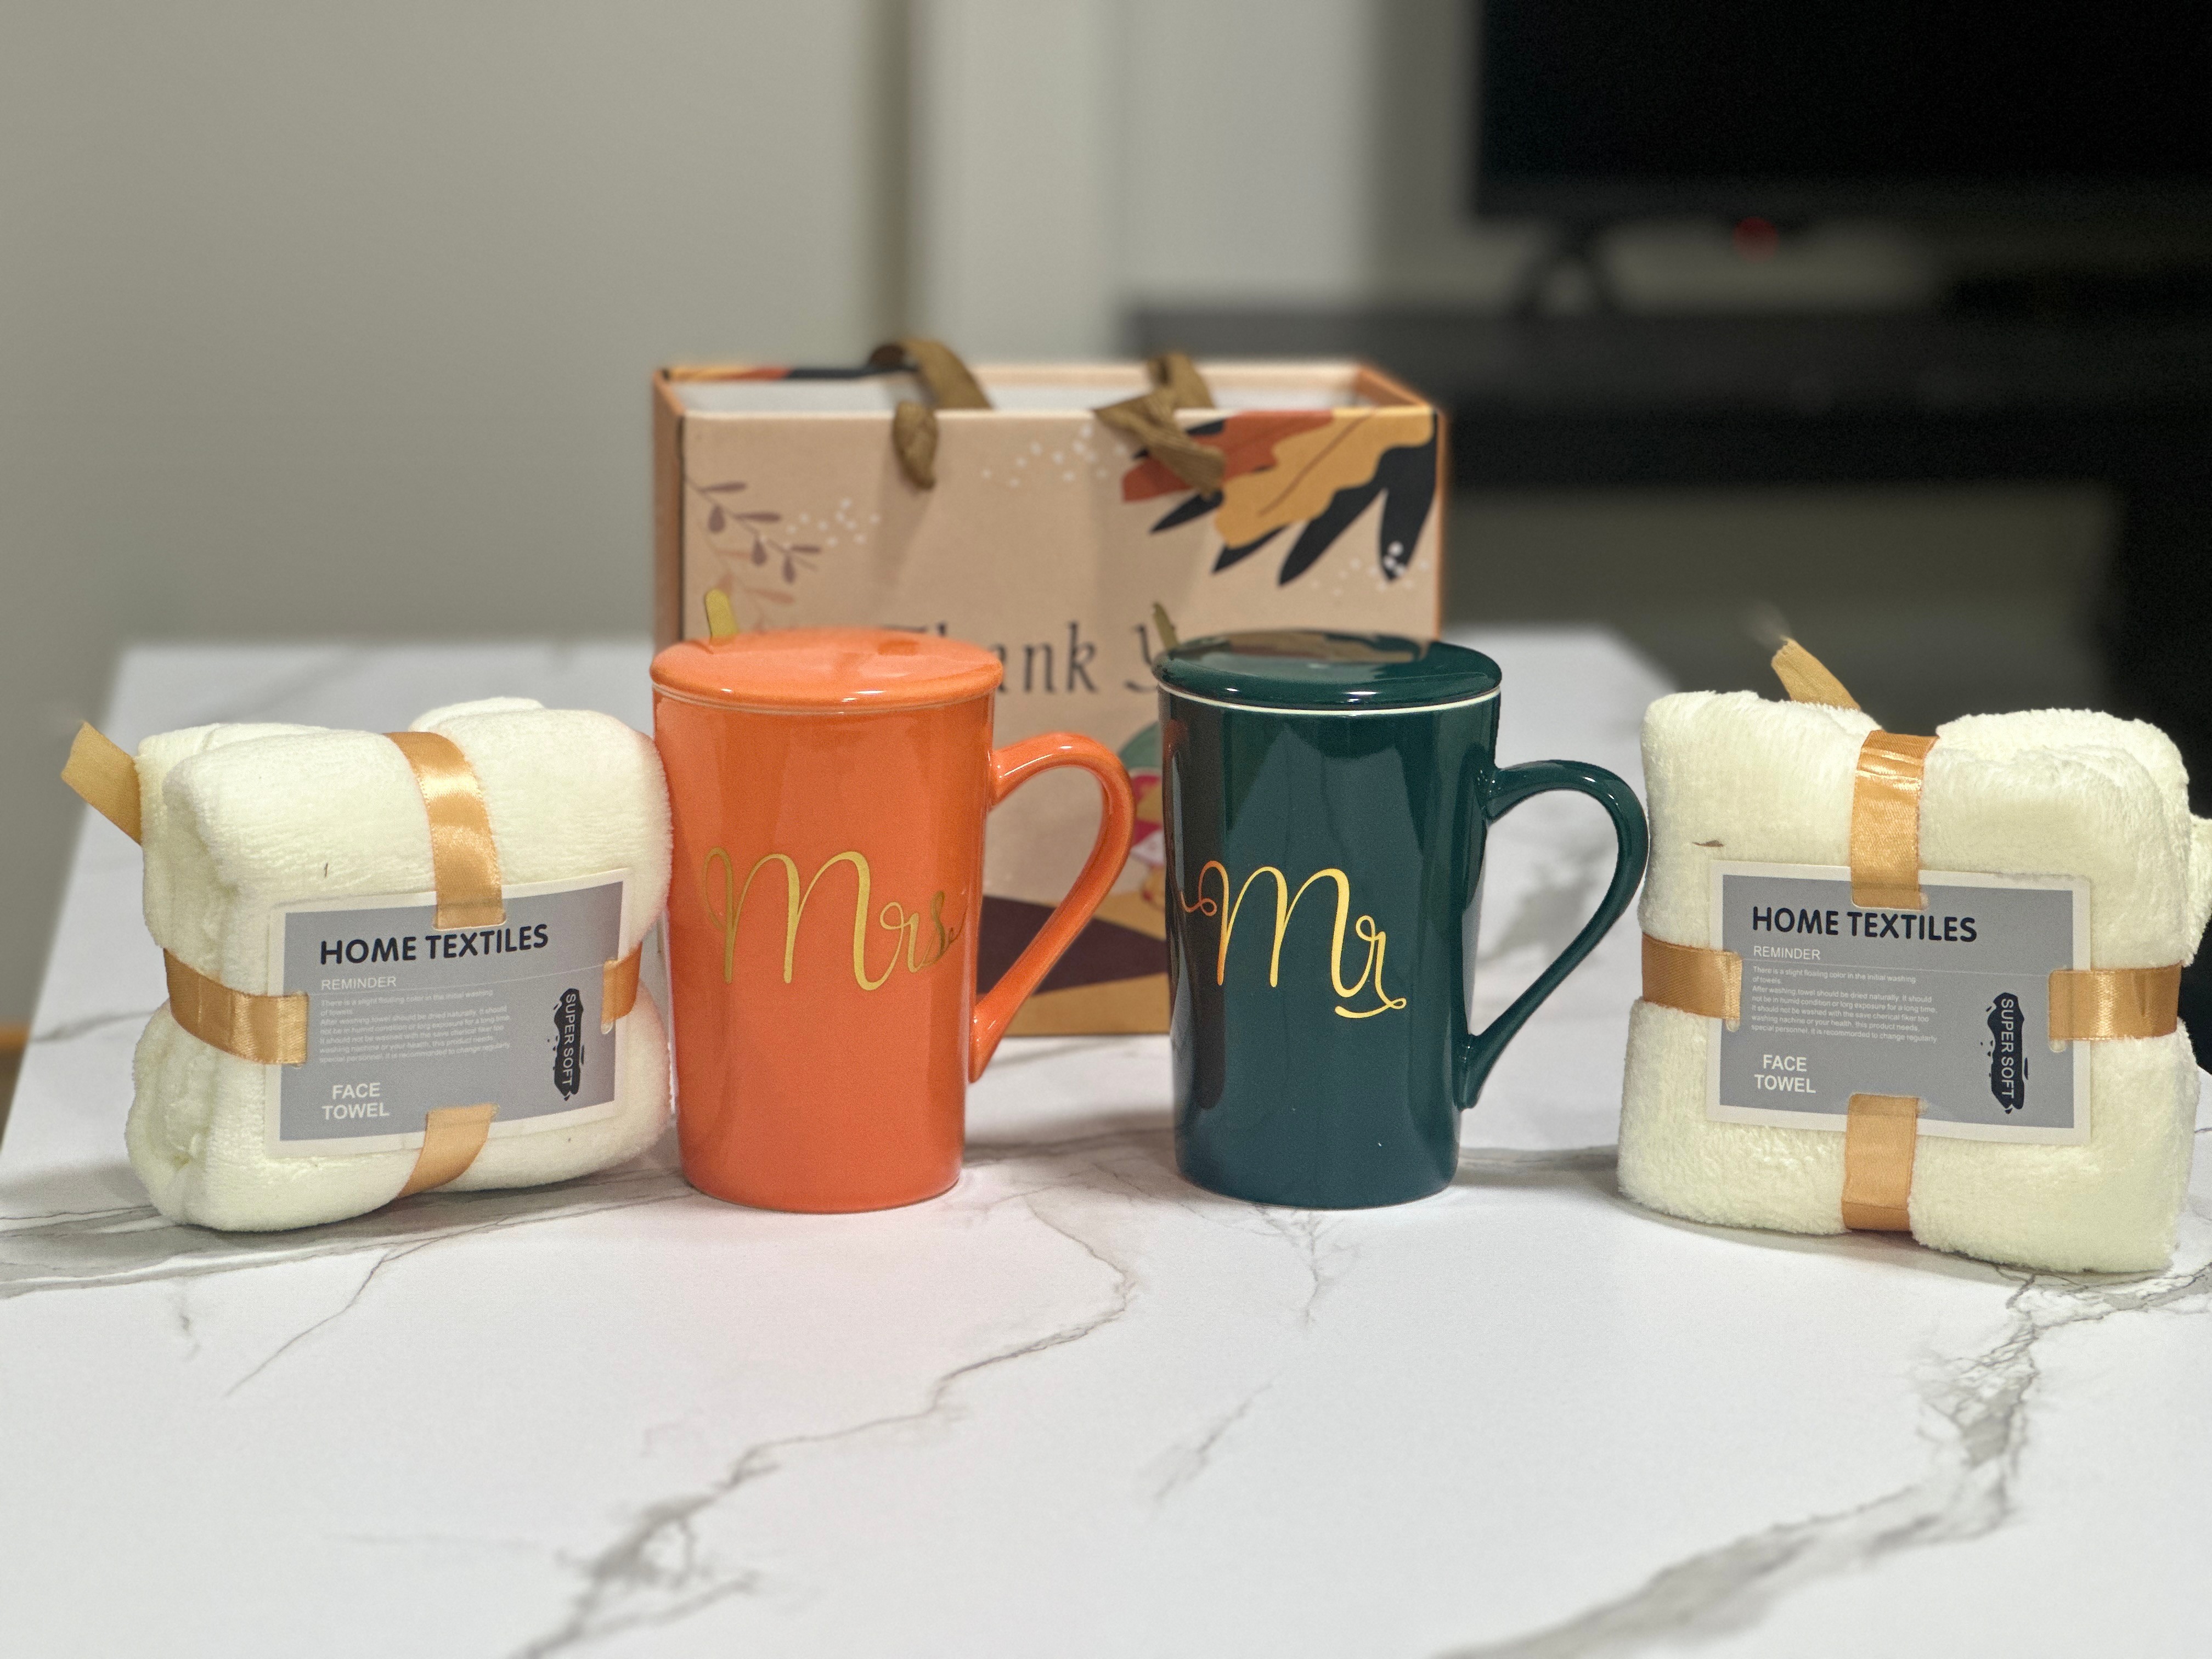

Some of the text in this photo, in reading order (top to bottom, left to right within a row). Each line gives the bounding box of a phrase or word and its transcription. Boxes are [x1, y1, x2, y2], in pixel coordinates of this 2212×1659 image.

[1752, 906, 1978, 943] HOME TEXTILES
[320, 924, 549, 966] HOME TEXTILES
[1180, 860, 1407, 1019] Mr
[1753, 946, 1821, 961] REMINDER
[321, 976, 397, 991] REMINDER
[559, 994, 577, 1086] SUPER SOFT
[2001, 998, 2015, 1099] SUPER SOFT
[1763, 1054, 1808, 1072] FACE
[332, 1082, 381, 1100] FACE
[1754, 1075, 1816, 1094] TOWEL
[322, 1102, 390, 1120] TOWEL
